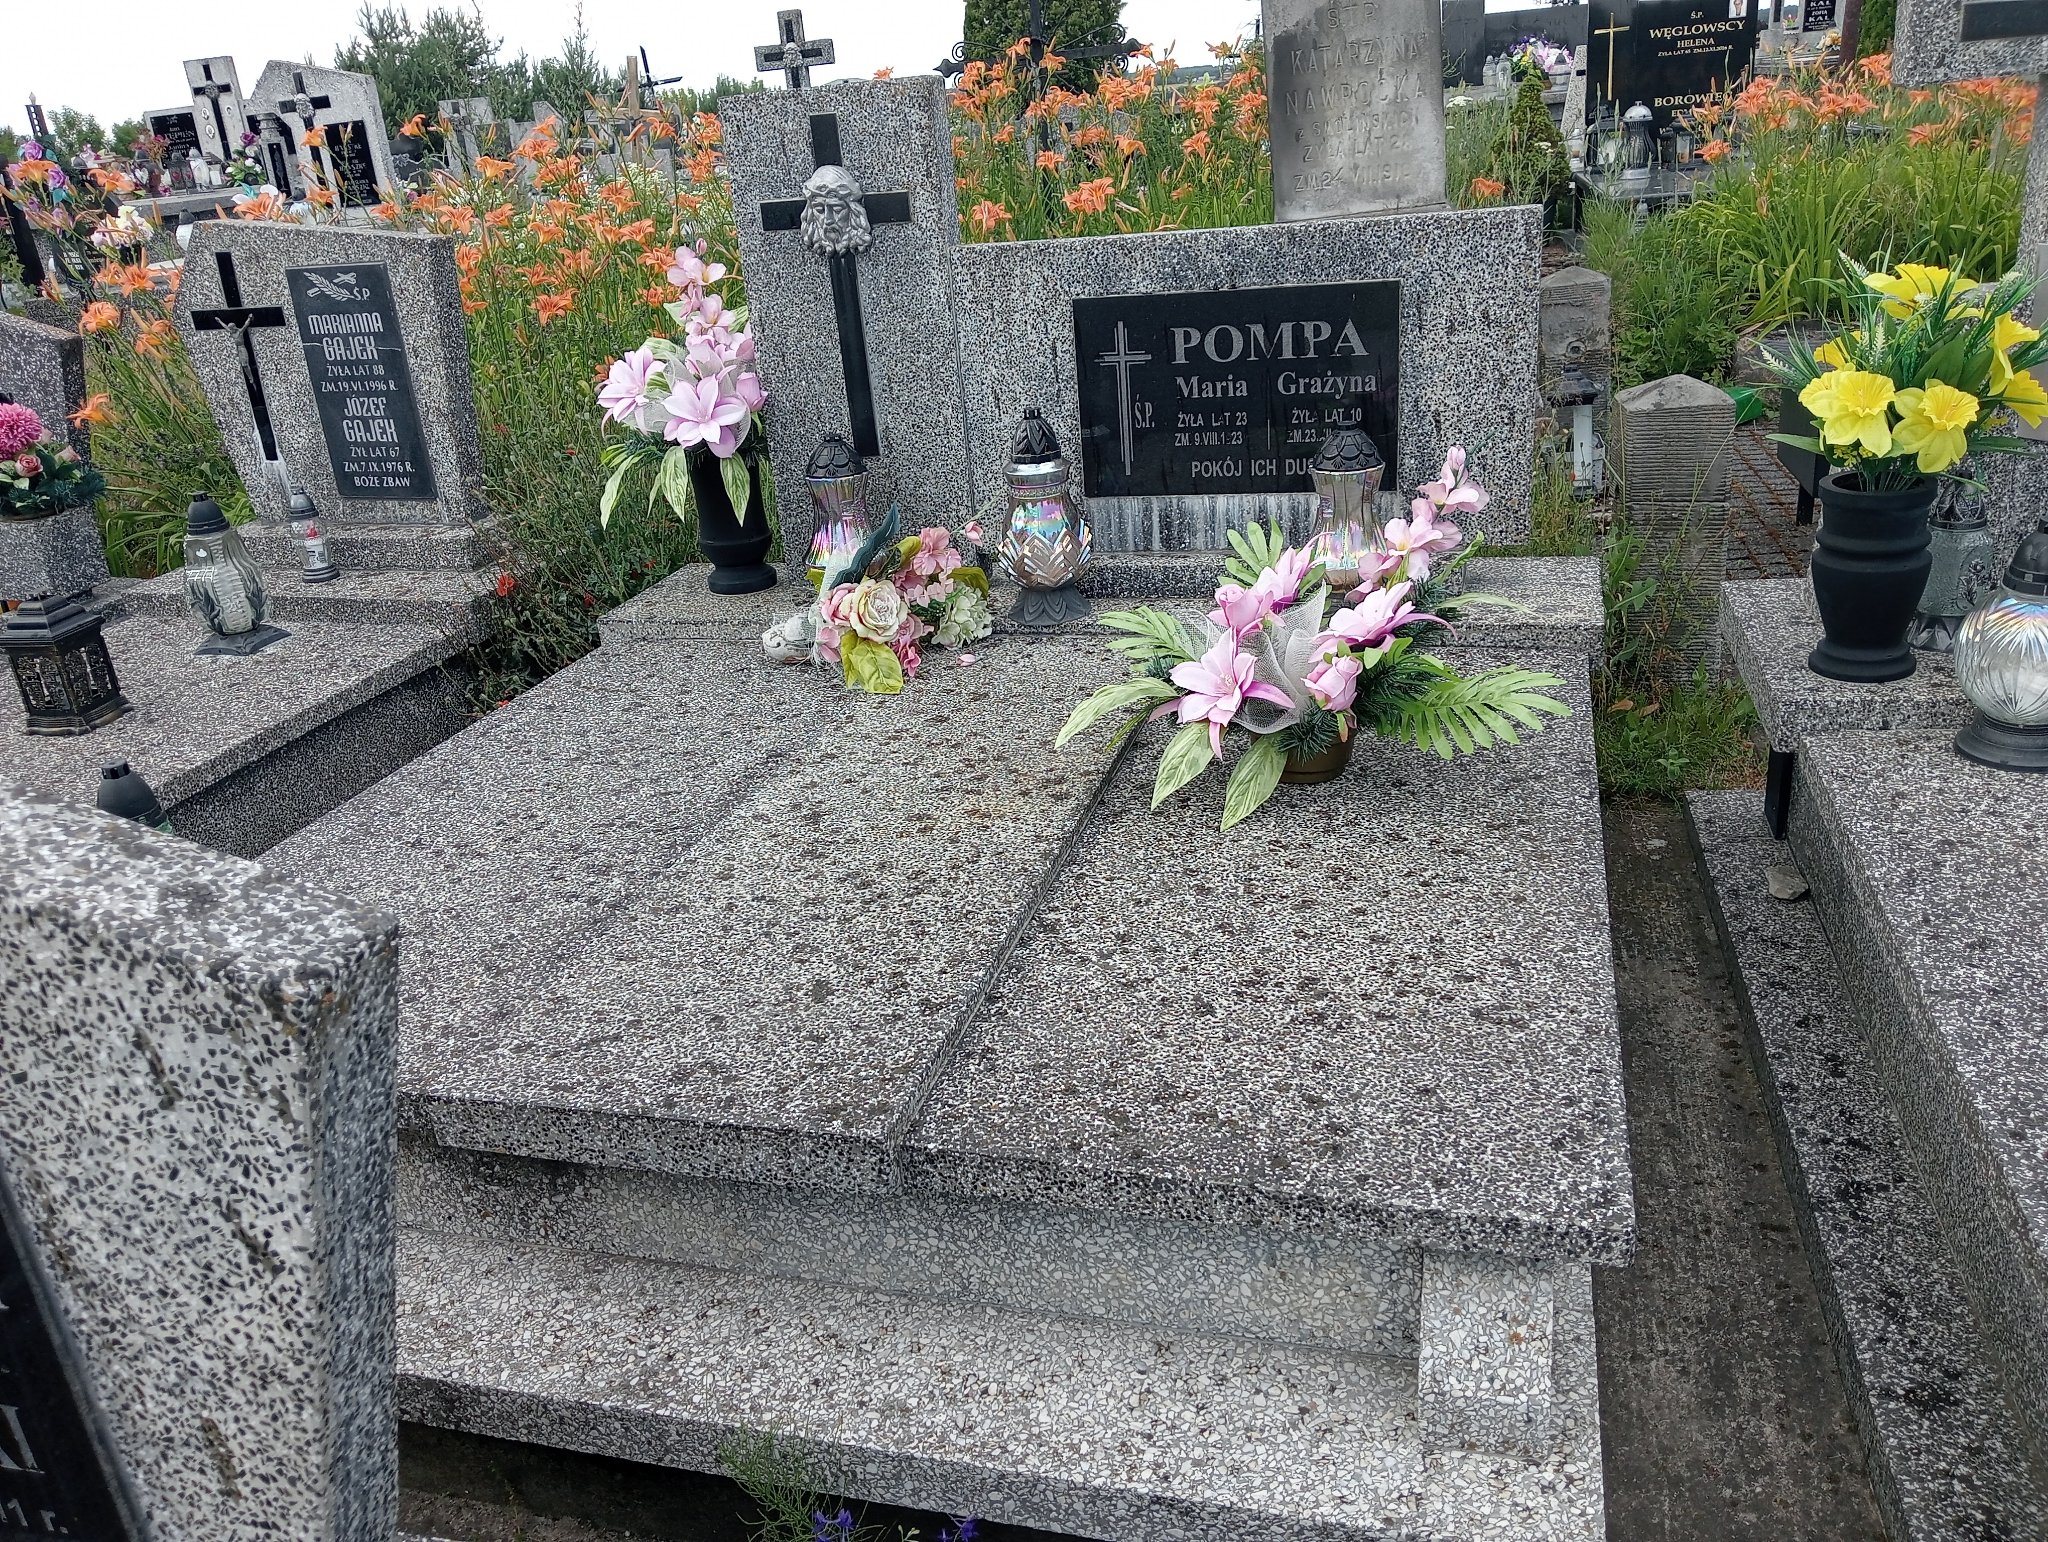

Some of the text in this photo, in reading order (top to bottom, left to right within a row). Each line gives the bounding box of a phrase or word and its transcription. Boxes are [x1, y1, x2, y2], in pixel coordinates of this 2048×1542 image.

[1648, 20, 1746, 40] WĘGLOWSCY
[1676, 37, 1715, 48] HELENA
[307, 312, 384, 335] MARIANNA
[322, 335, 379, 362] GAJEK
[1169, 318, 1370, 365] POMPA
[326, 364, 385, 377] ŻYŁA LAT 88
[1175, 370, 1378, 400] Maria Grażyna
[343, 394, 388, 417] JÓZEF
[1324, 407, 1345, 423] LAT
[1350, 407, 1362, 422] 10
[1177, 411, 1248, 428] ŻYŁA LAT 23
[342, 418, 399, 443] GAJEK
[350, 444, 400, 458] ŻYŁ LAT 67
[1191, 455, 1315, 478] POKÓJ ICH DUS
[354, 474, 411, 487] BOŻE ZBAW
